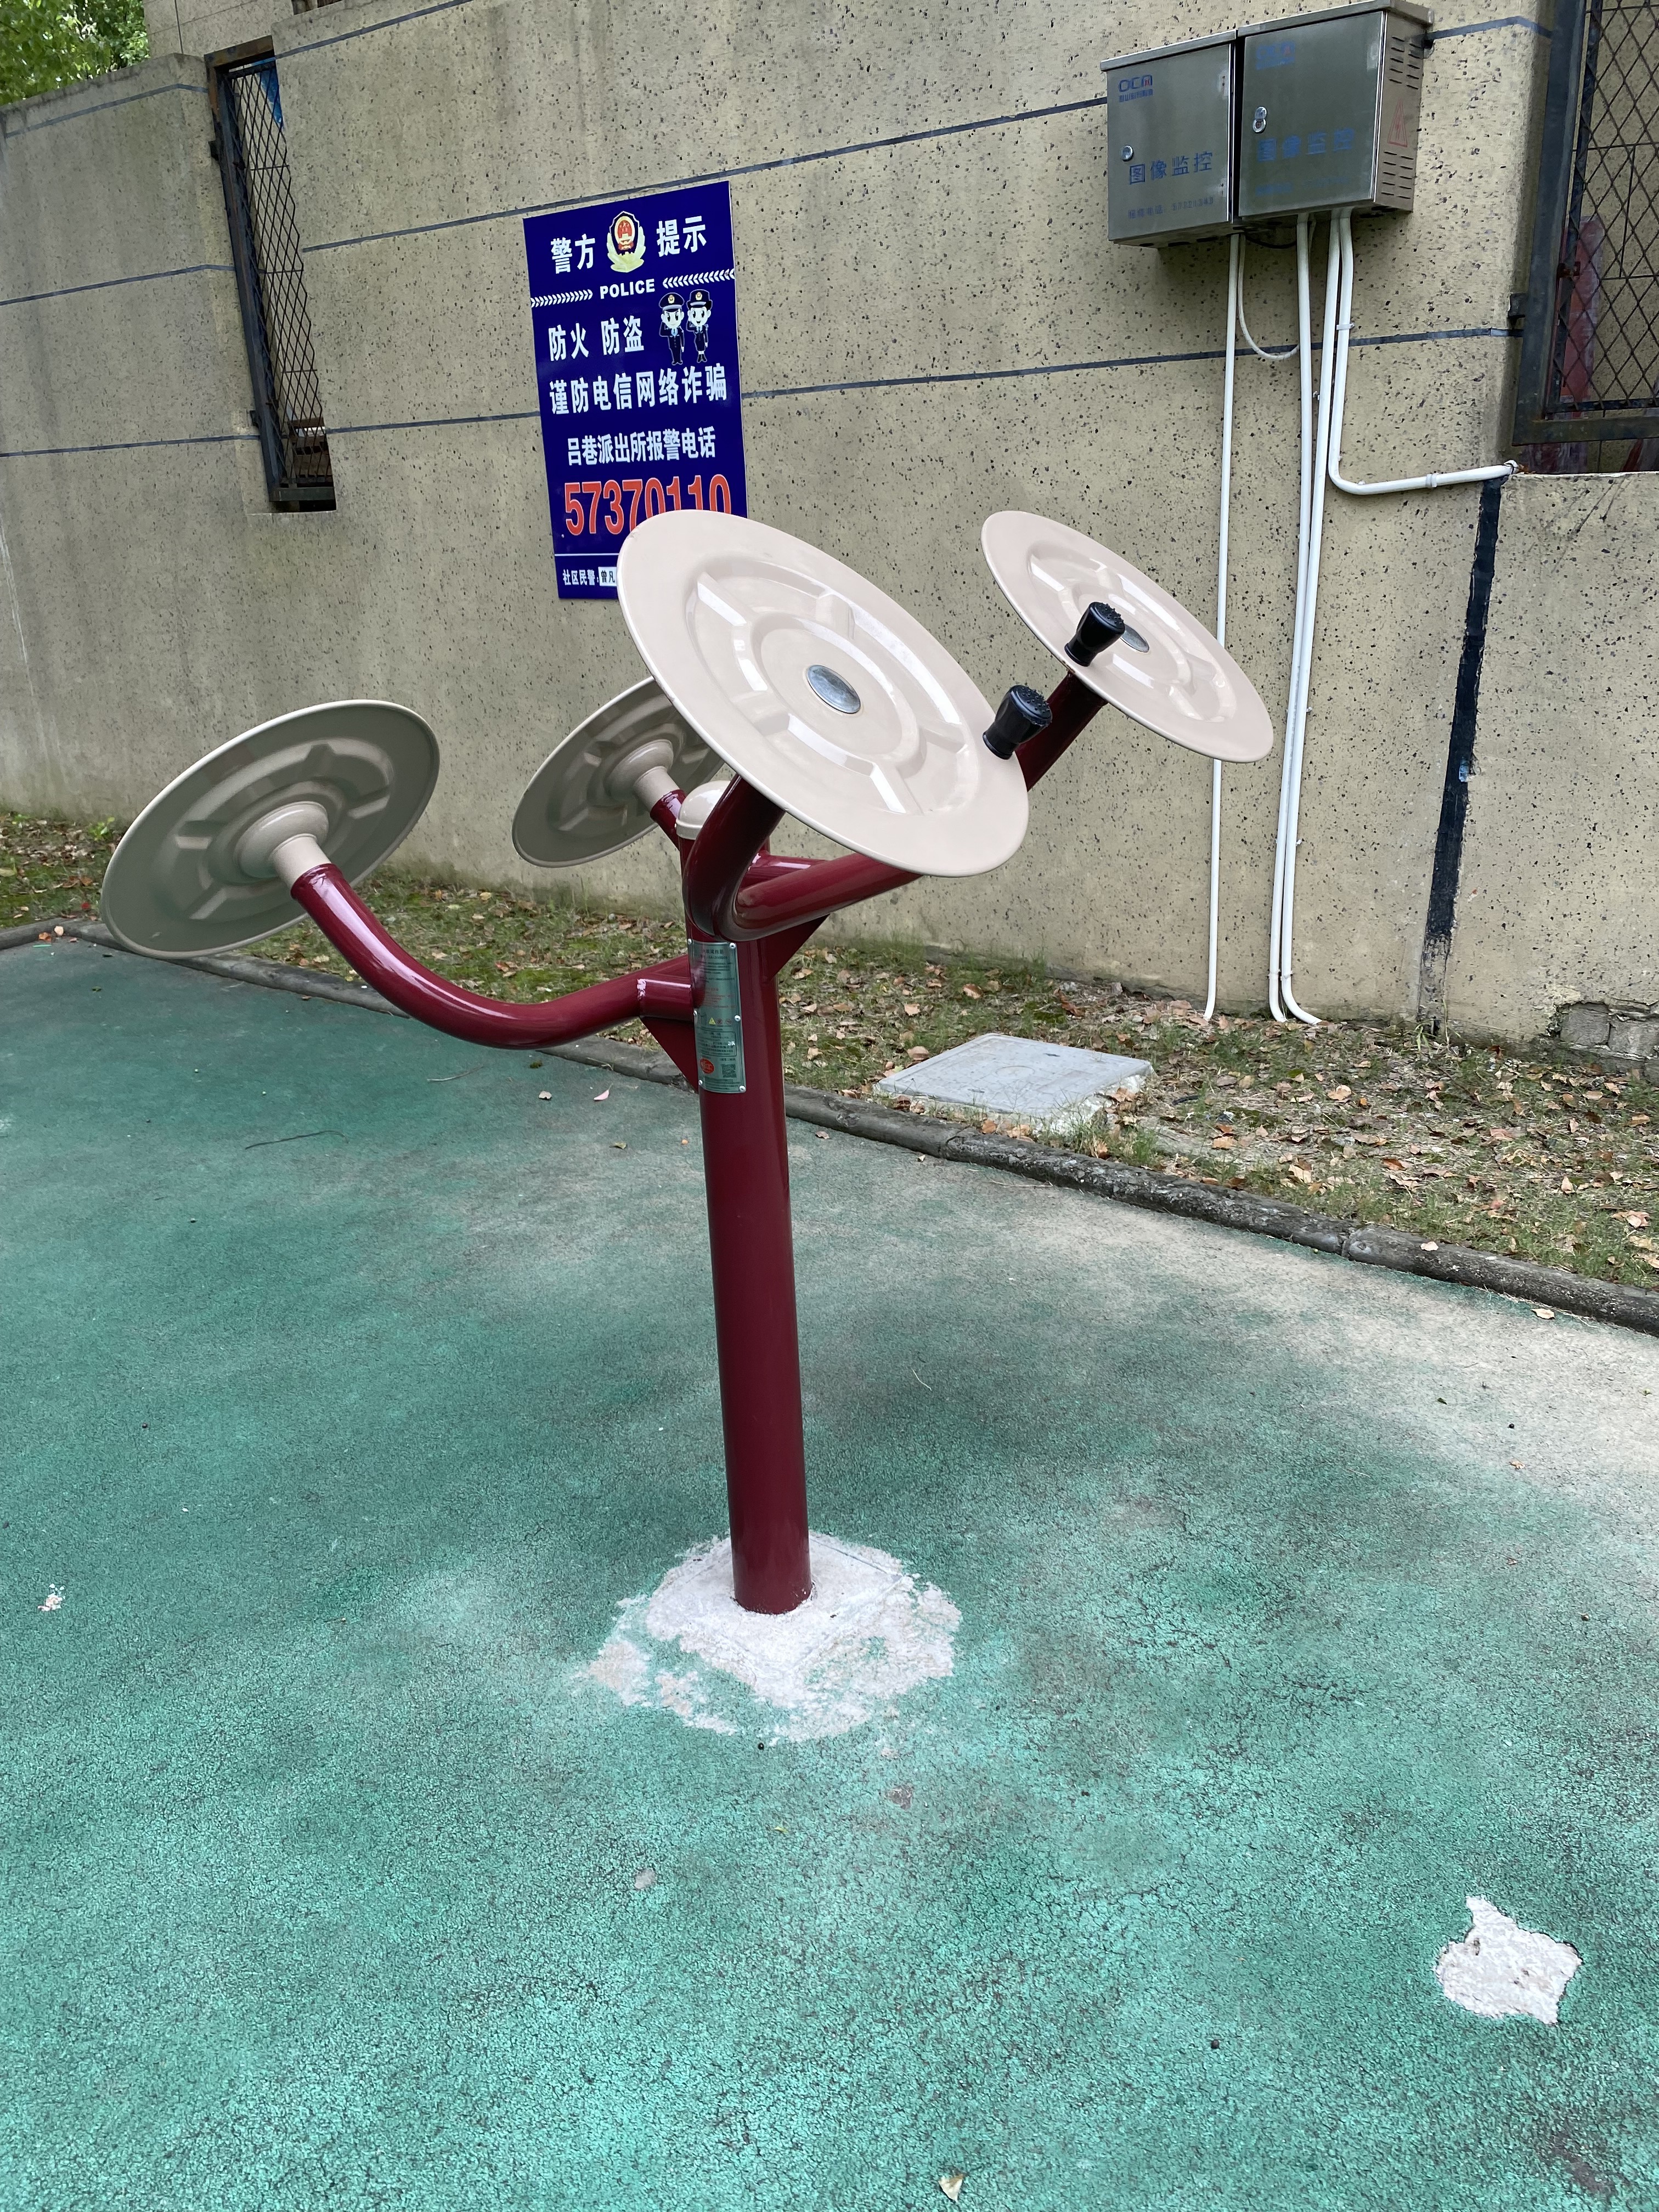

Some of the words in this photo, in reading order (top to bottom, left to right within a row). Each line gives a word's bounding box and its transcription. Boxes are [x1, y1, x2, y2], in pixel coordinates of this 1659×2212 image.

[1129, 151, 1213, 185] 图像监控
[550, 234, 595, 274] 警方
[656, 215, 707, 257] 提示
[600, 279, 655, 299] POLICE
[549, 323, 589, 362] 防火
[601, 315, 644, 355] 防盗
[549, 363, 727, 415] 谨防电信网络诈骗
[567, 426, 716, 466] 吕巷派出所报警电话
[564, 474, 732, 535] 57370110
